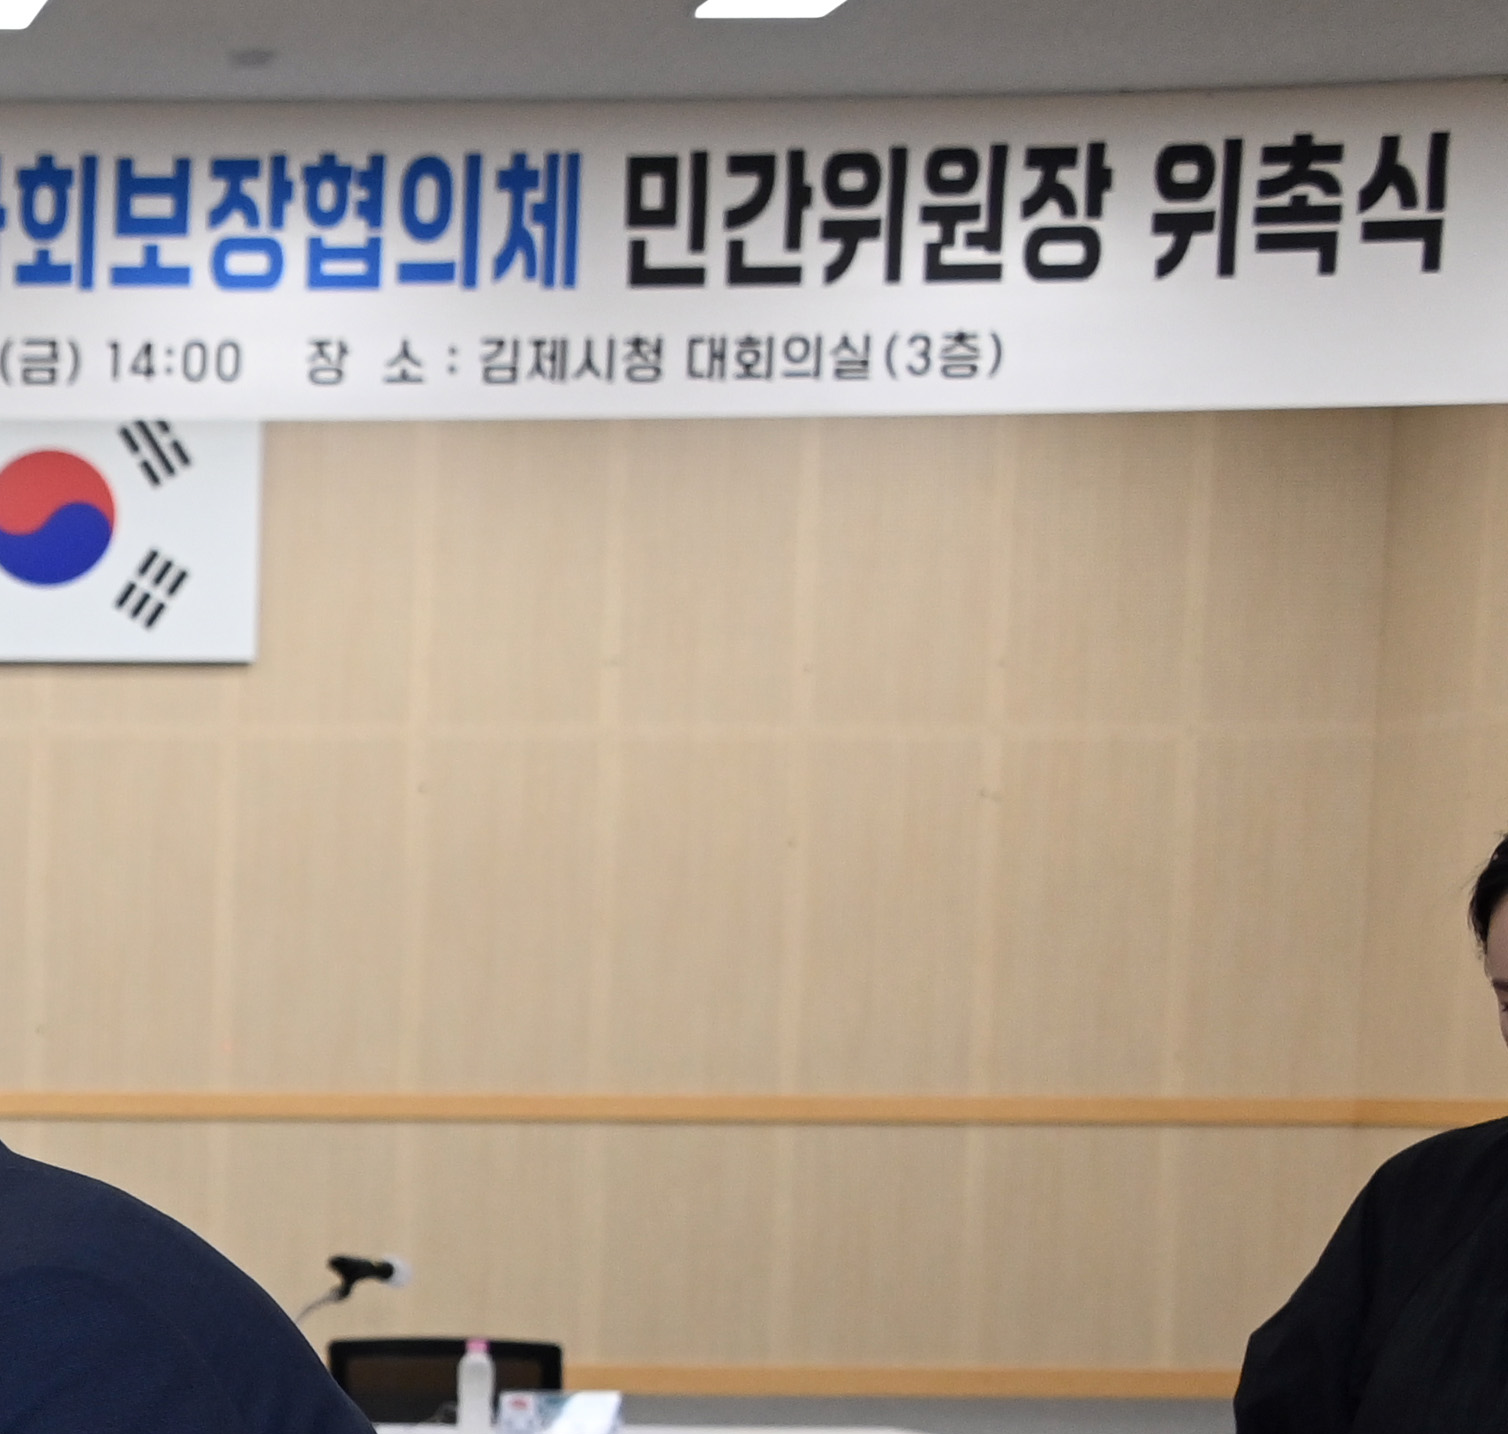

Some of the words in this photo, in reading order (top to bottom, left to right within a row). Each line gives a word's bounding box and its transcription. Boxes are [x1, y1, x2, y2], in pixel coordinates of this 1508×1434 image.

[623, 137, 1115, 288] 민간위원장
[1149, 129, 1454, 279] 위촉식
[109, 340, 243, 383] 14:00
[479, 335, 664, 385] 김제시청
[687, 332, 1005, 381] 대회의실(3층)
